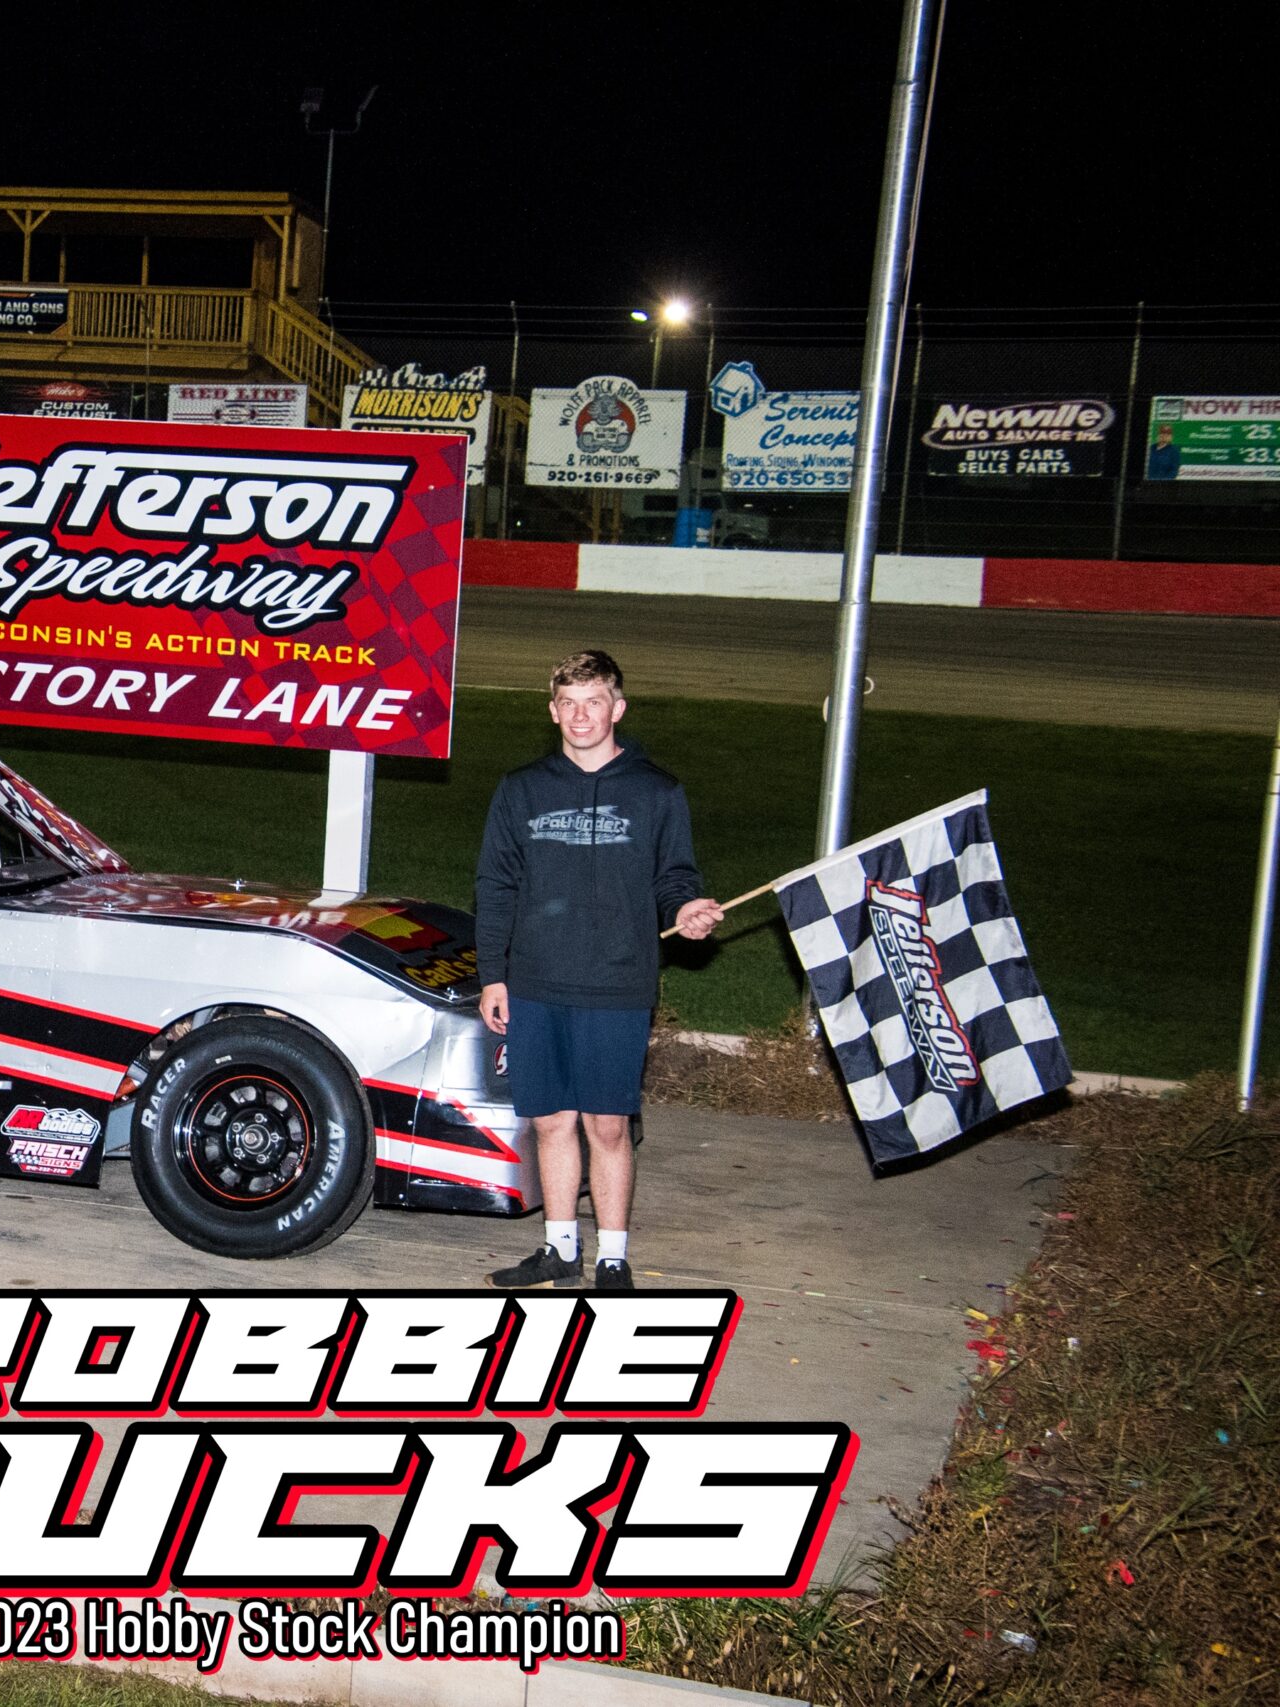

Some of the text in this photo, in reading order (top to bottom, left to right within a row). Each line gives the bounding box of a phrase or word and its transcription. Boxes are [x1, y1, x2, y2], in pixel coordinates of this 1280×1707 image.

[4, 301, 29, 313] AND
[32, 302, 64, 314] SONS
[179, 387, 298, 401] RED LINE
[584, 379, 614, 398] PACK
[41, 401, 110, 411] CUSTOM
[353, 386, 484, 420] MORRISON'S
[764, 392, 860, 422] Serenit
[1184, 399, 1243, 415] NOW
[931, 403, 1102, 429] Newville
[759, 423, 857, 451] Concep
[942, 430, 990, 442] AUTO
[995, 430, 1073, 442] SALVAGE
[578, 454, 641, 468] PROMOTIONS
[965, 448, 1065, 462] BUYS CARS
[958, 461, 1071, 474] SELLS PARTS
[145, 631, 260, 658] ACTION
[272, 641, 376, 667] TRACK
[207, 676, 413, 731] LANE
[539, 814, 622, 832] Pathfinder
[868, 882, 978, 1084] Jefferson
[874, 911, 952, 1089] SPEEDWAY
[140, 1057, 187, 1131] RACER
[38, 1114, 95, 1136] bodies
[9, 1139, 89, 1161] FRISCH
[39, 1156, 81, 1169] SIGNS
[276, 1118, 346, 1232] AMERICAN
